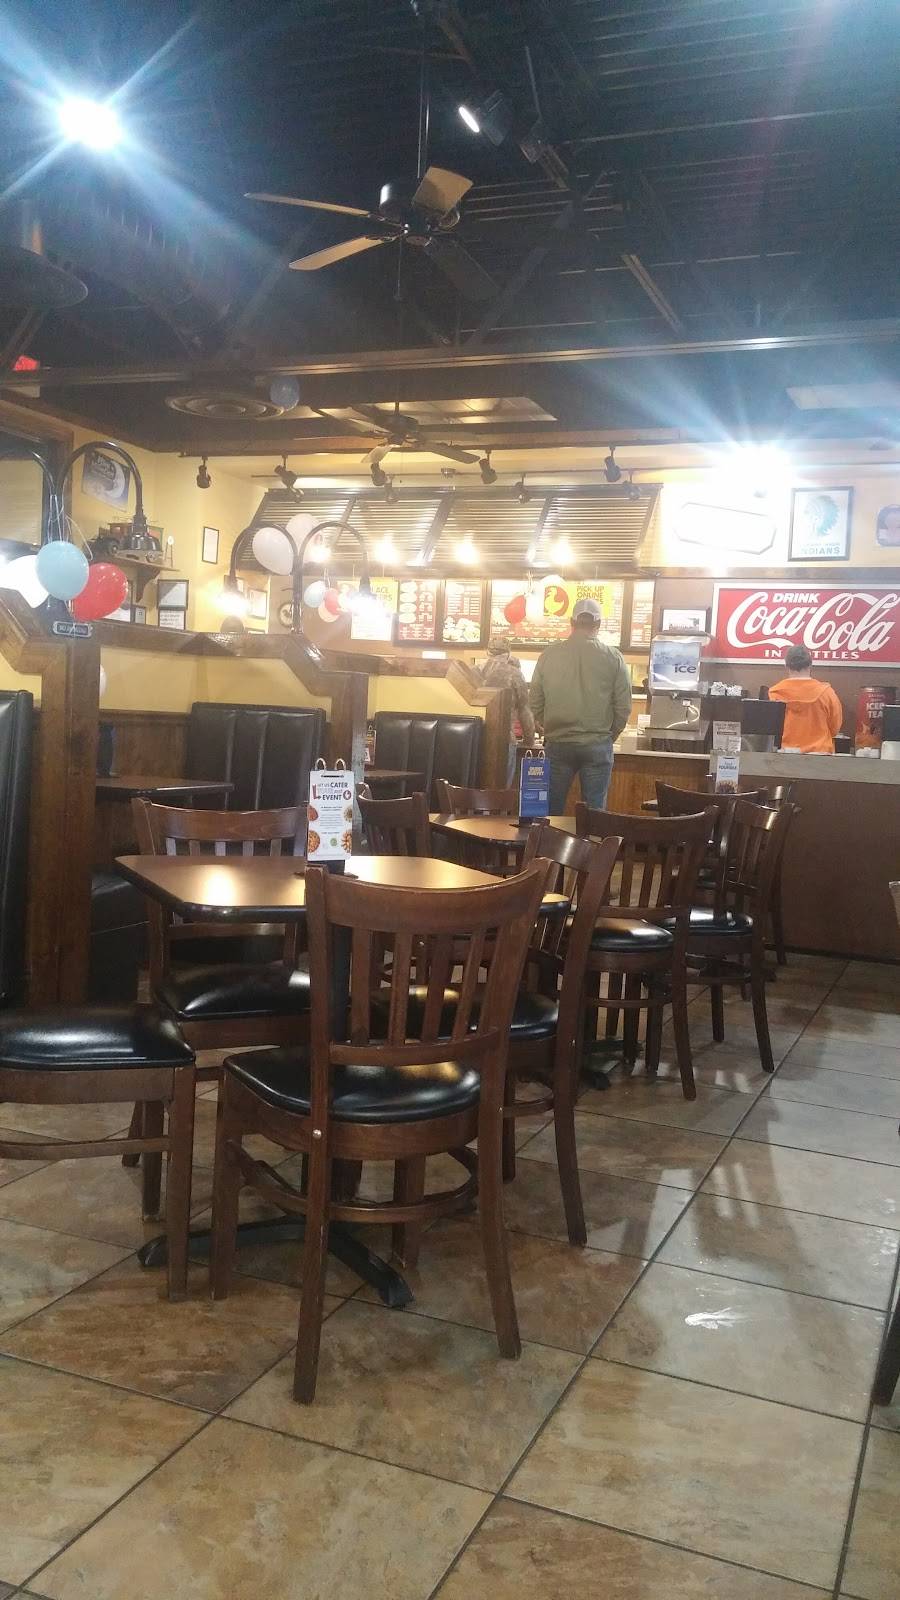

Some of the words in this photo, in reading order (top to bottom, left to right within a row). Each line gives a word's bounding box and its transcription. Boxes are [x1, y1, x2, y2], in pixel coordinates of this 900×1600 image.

[799, 547, 841, 555] NDIANS
[772, 592, 820, 604] DRINK
[764, 649, 782, 658] IN
[809, 650, 860, 660] TTLES
[674, 663, 697, 674] ice
[868, 710, 884, 719] TEA
